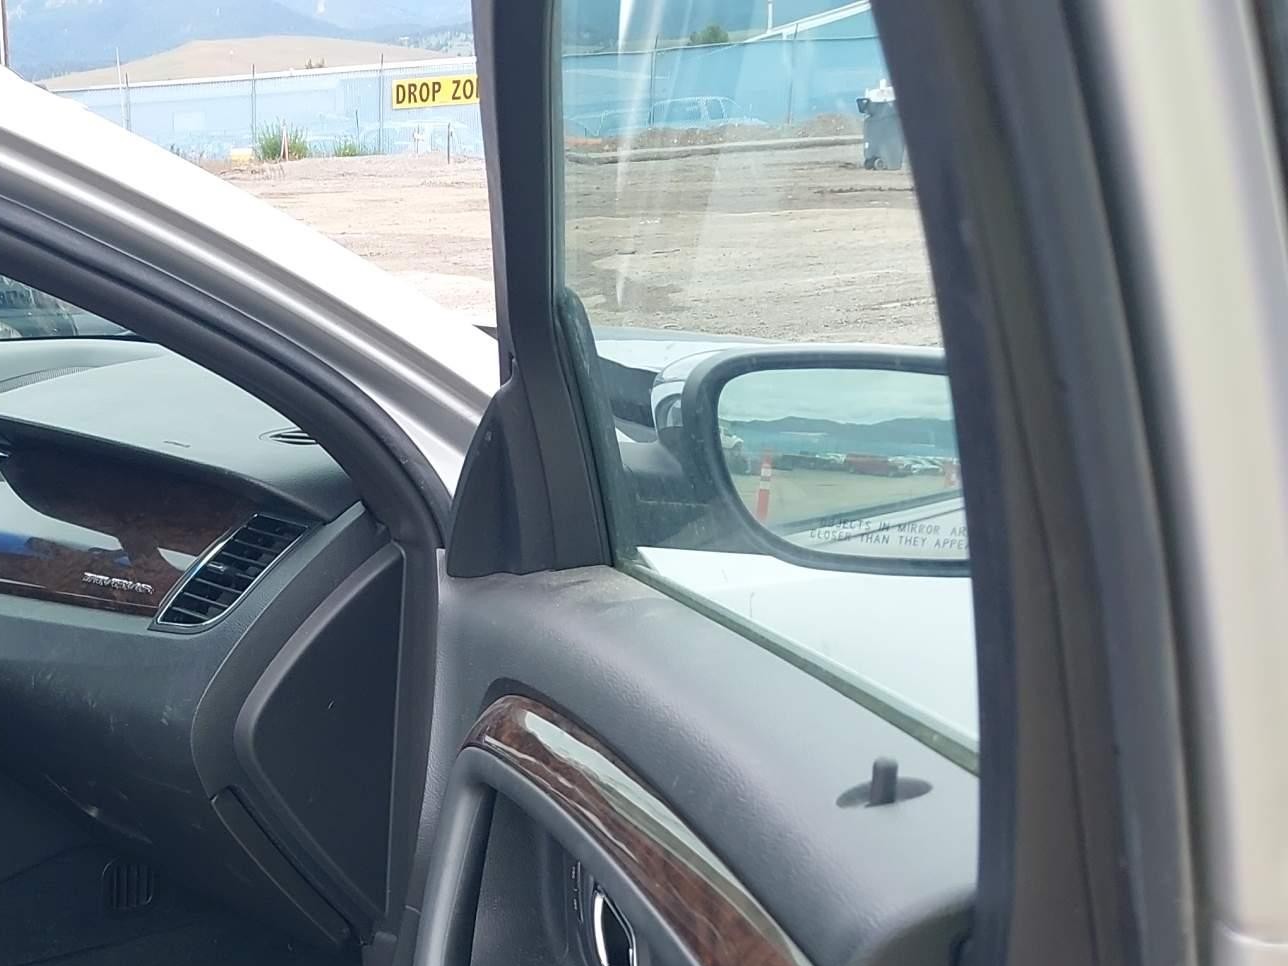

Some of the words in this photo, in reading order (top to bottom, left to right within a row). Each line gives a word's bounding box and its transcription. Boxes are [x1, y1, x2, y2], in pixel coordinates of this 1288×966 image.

[396, 82, 442, 105] DROP
[452, 79, 479, 100] ZO
[821, 519, 871, 531] OBJECTS
[879, 523, 890, 532] IN
[899, 524, 940, 536] MIRROR
[810, 528, 851, 541] CLOSER
[860, 534, 890, 545] THAN
[899, 536, 927, 548] THEY
